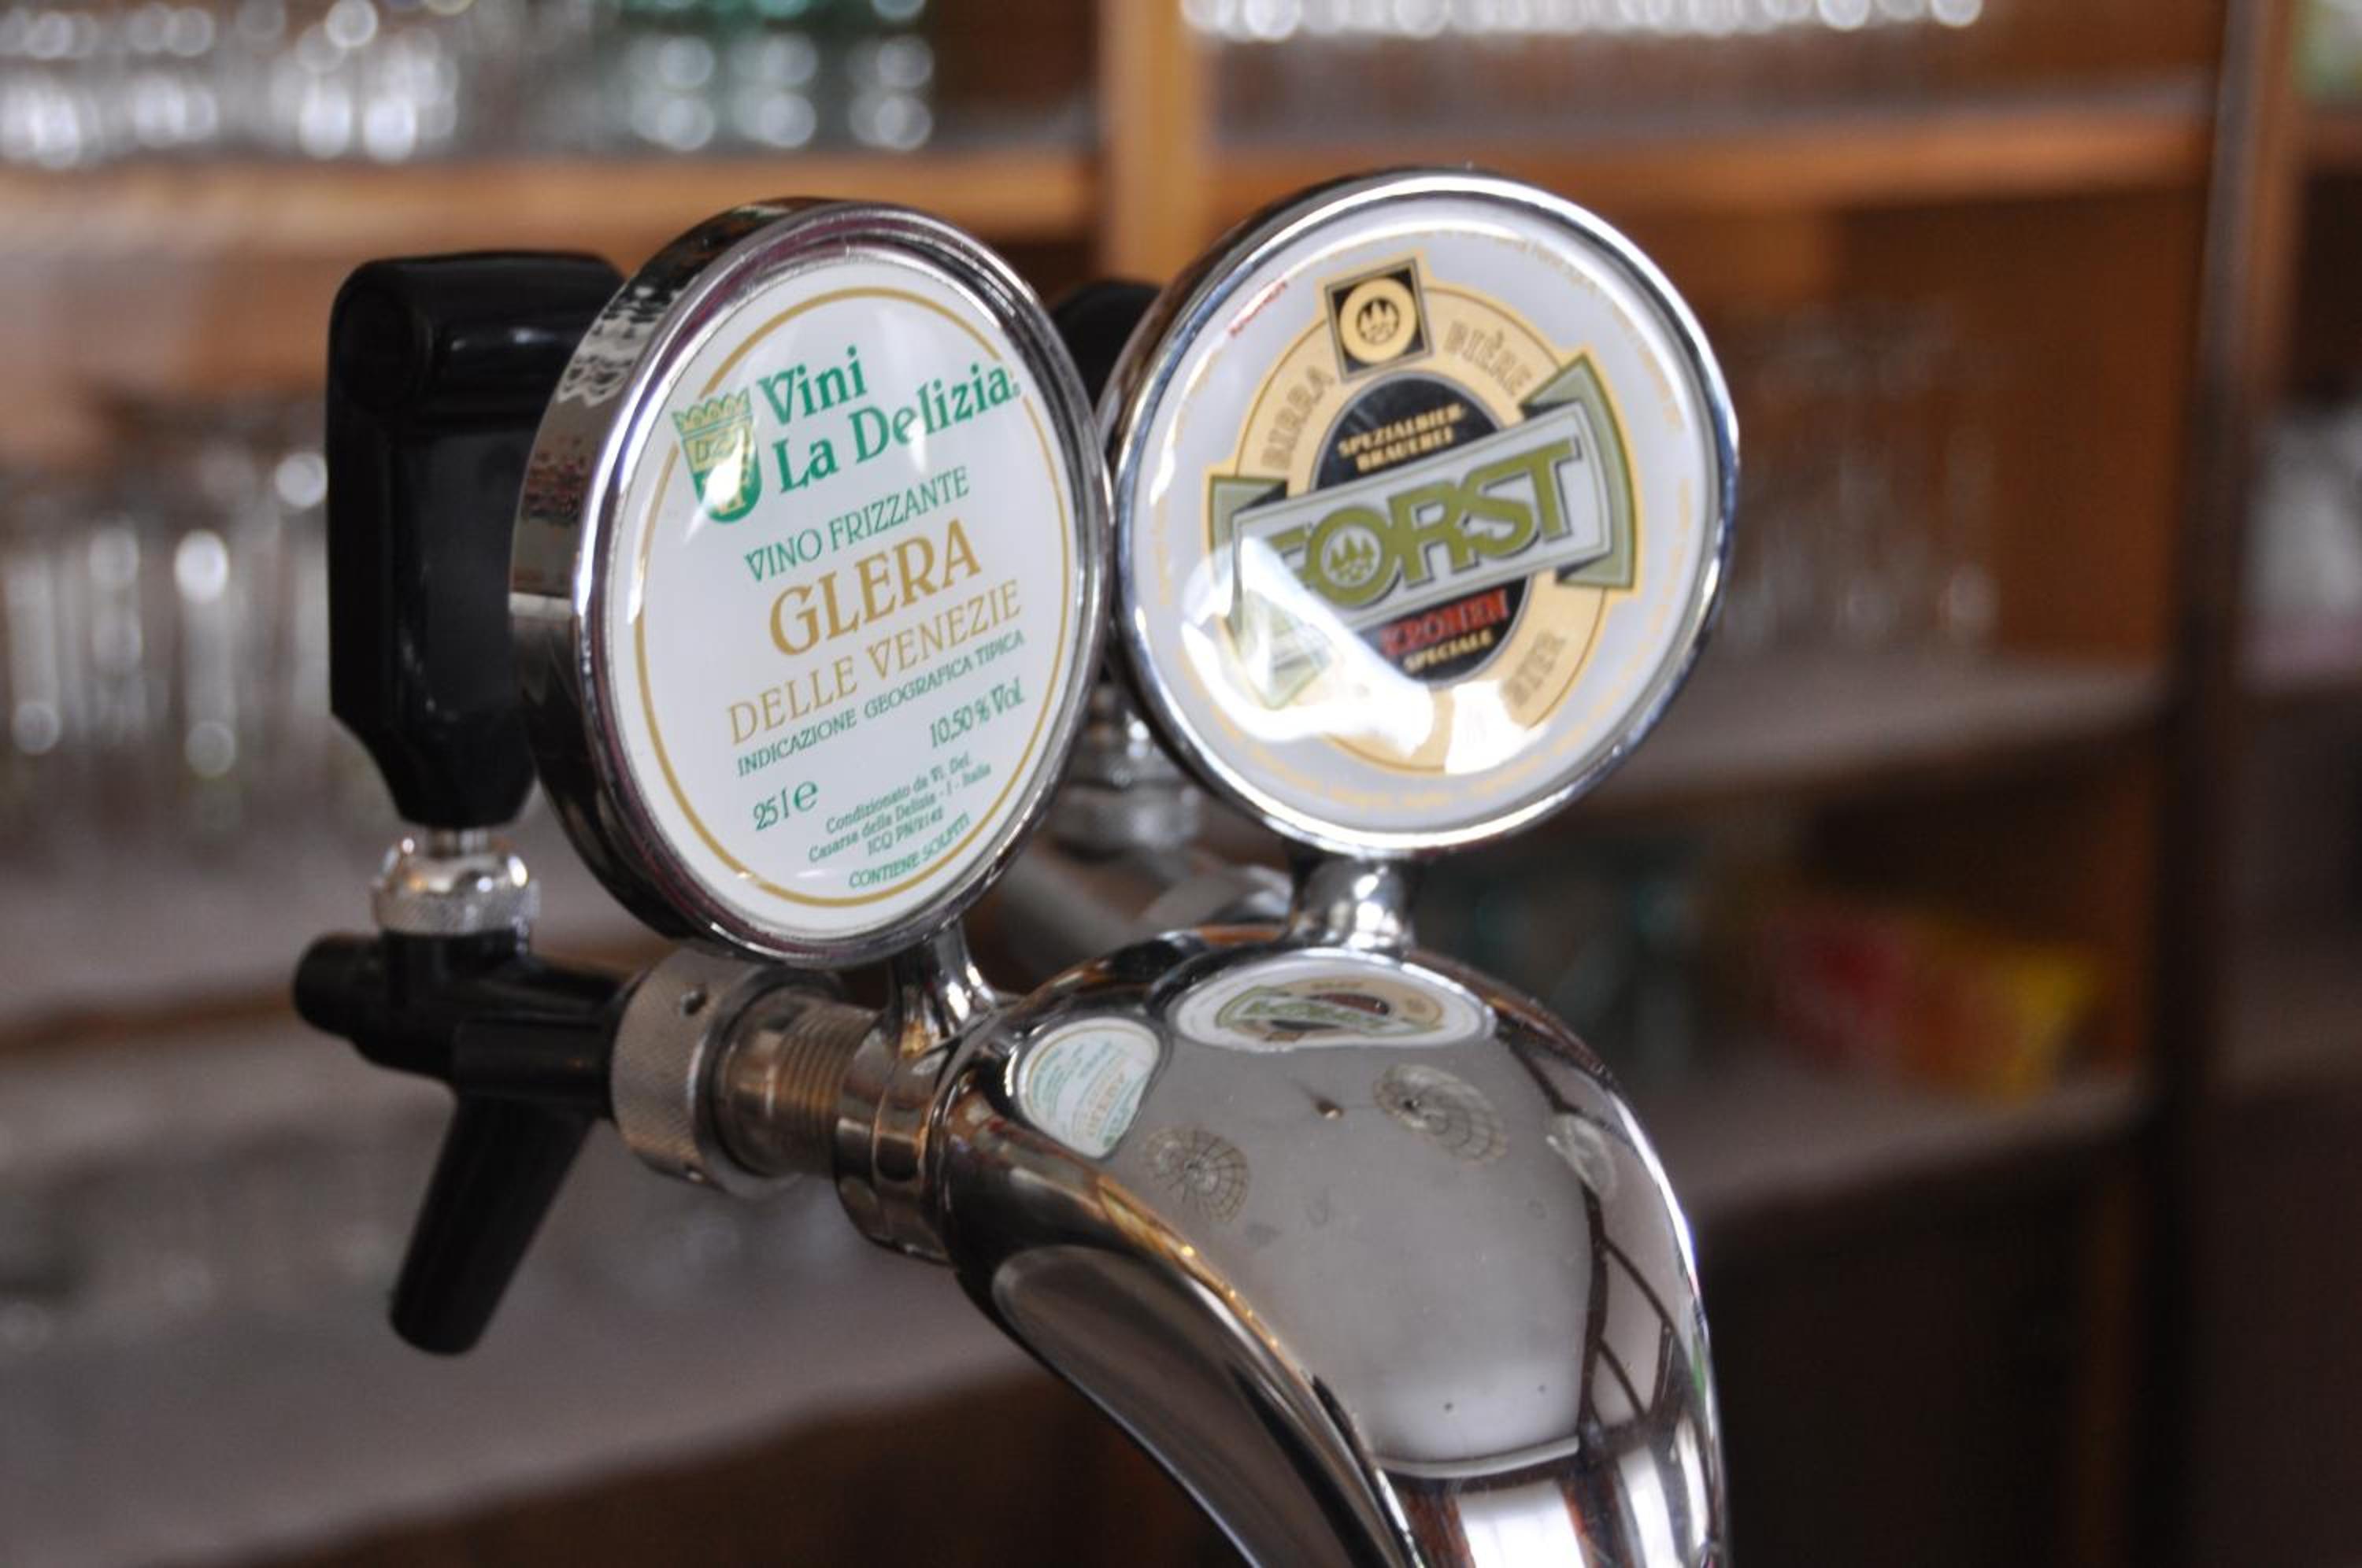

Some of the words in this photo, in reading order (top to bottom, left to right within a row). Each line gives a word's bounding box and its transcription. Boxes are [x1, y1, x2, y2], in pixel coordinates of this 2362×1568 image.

[757, 346, 868, 425] Vini
[772, 435, 839, 494] La
[848, 362, 1013, 464] Delizia
[1356, 425, 1454, 472] BRAUEREI
[743, 528, 823, 583] VINO
[829, 466, 969, 551] FRIZZANTE
[769, 517, 981, 656] GLERA
[728, 655, 857, 745] DELLE
[866, 579, 1021, 681] VENEZIE
[737, 708, 857, 776] INDICAZIONE
[863, 653, 973, 719] GEOGRAFICA
[975, 630, 1026, 668] TIPICA
[1403, 629, 1494, 671] SPECIALE
[849, 851, 920, 889] CONTIENE
